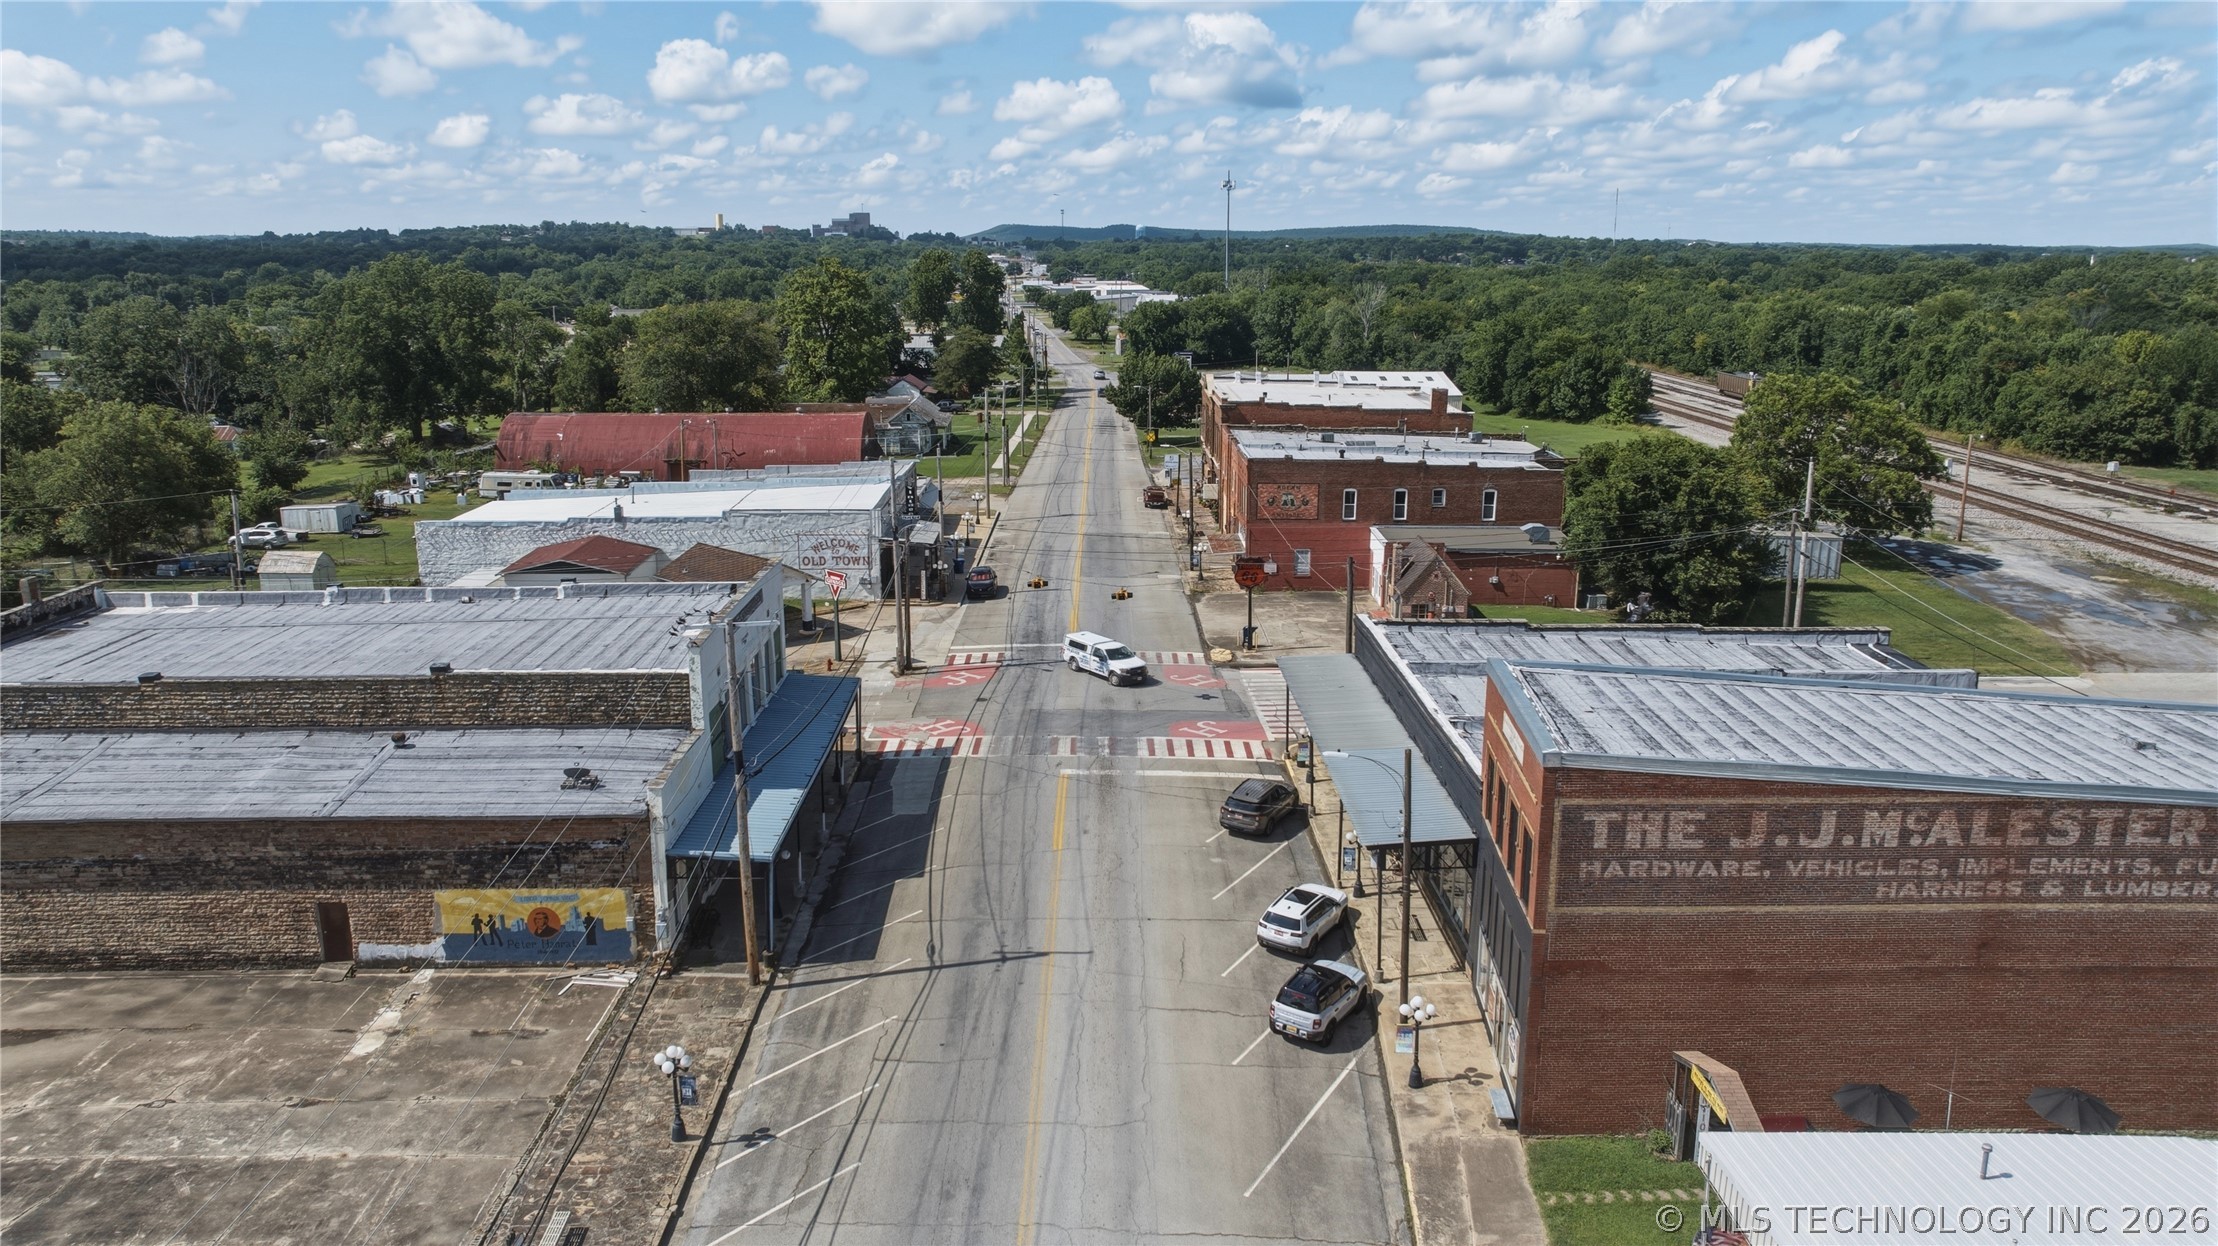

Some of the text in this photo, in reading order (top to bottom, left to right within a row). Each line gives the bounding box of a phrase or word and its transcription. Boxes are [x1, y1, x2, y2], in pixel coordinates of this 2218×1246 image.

[811, 538, 860, 555] WELCOME
[802, 556, 870, 567] OLD TOWN
[1584, 811, 1706, 849] THE
[1579, 859, 1770, 879] HARDWARE,
[1786, 858, 1948, 880] VEHICLES,
[1958, 856, 2161, 877] IMPLEMENTS,
[1876, 880, 2022, 898] HARNESS
[2040, 880, 2065, 897] &
